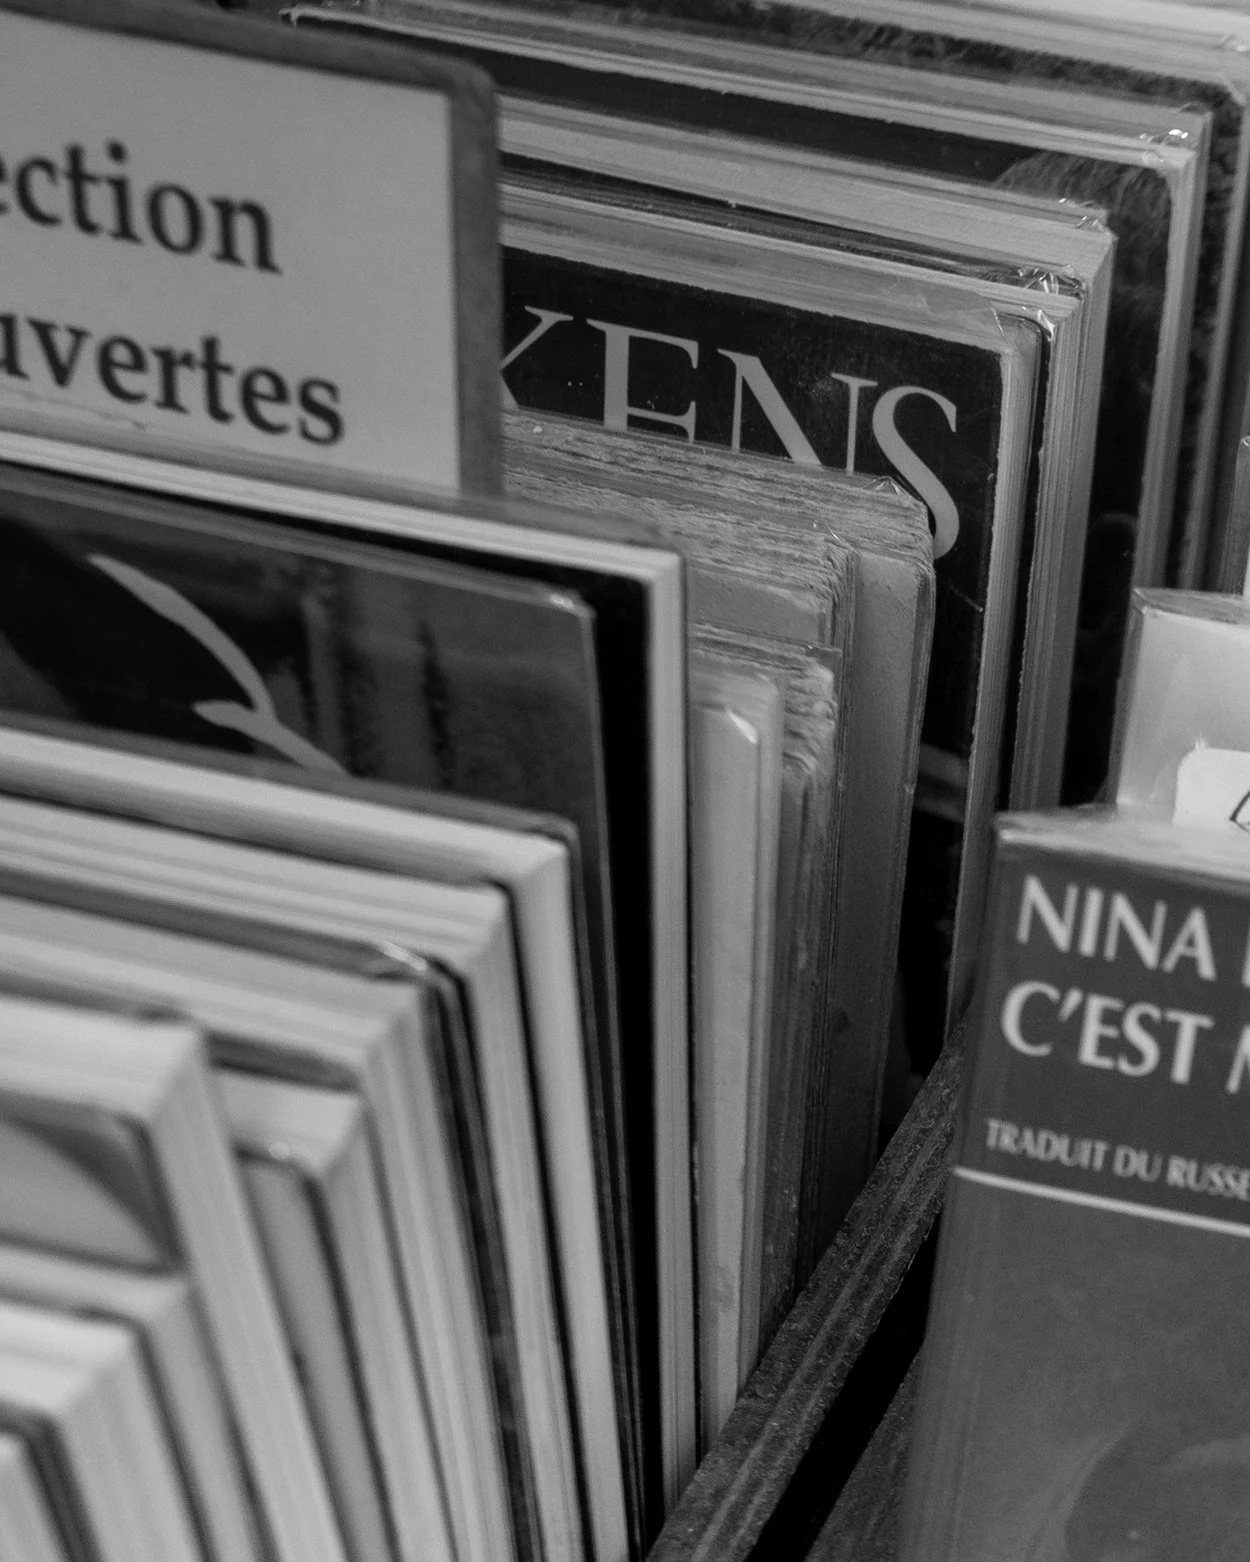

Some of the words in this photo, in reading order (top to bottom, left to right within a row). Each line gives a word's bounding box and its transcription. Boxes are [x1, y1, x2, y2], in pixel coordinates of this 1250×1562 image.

[1017, 874, 1216, 983] NINA
[1003, 981, 1214, 1085] C'EST
[986, 1118, 1110, 1172] TRADUIT
[1113, 1145, 1163, 1182] DU
